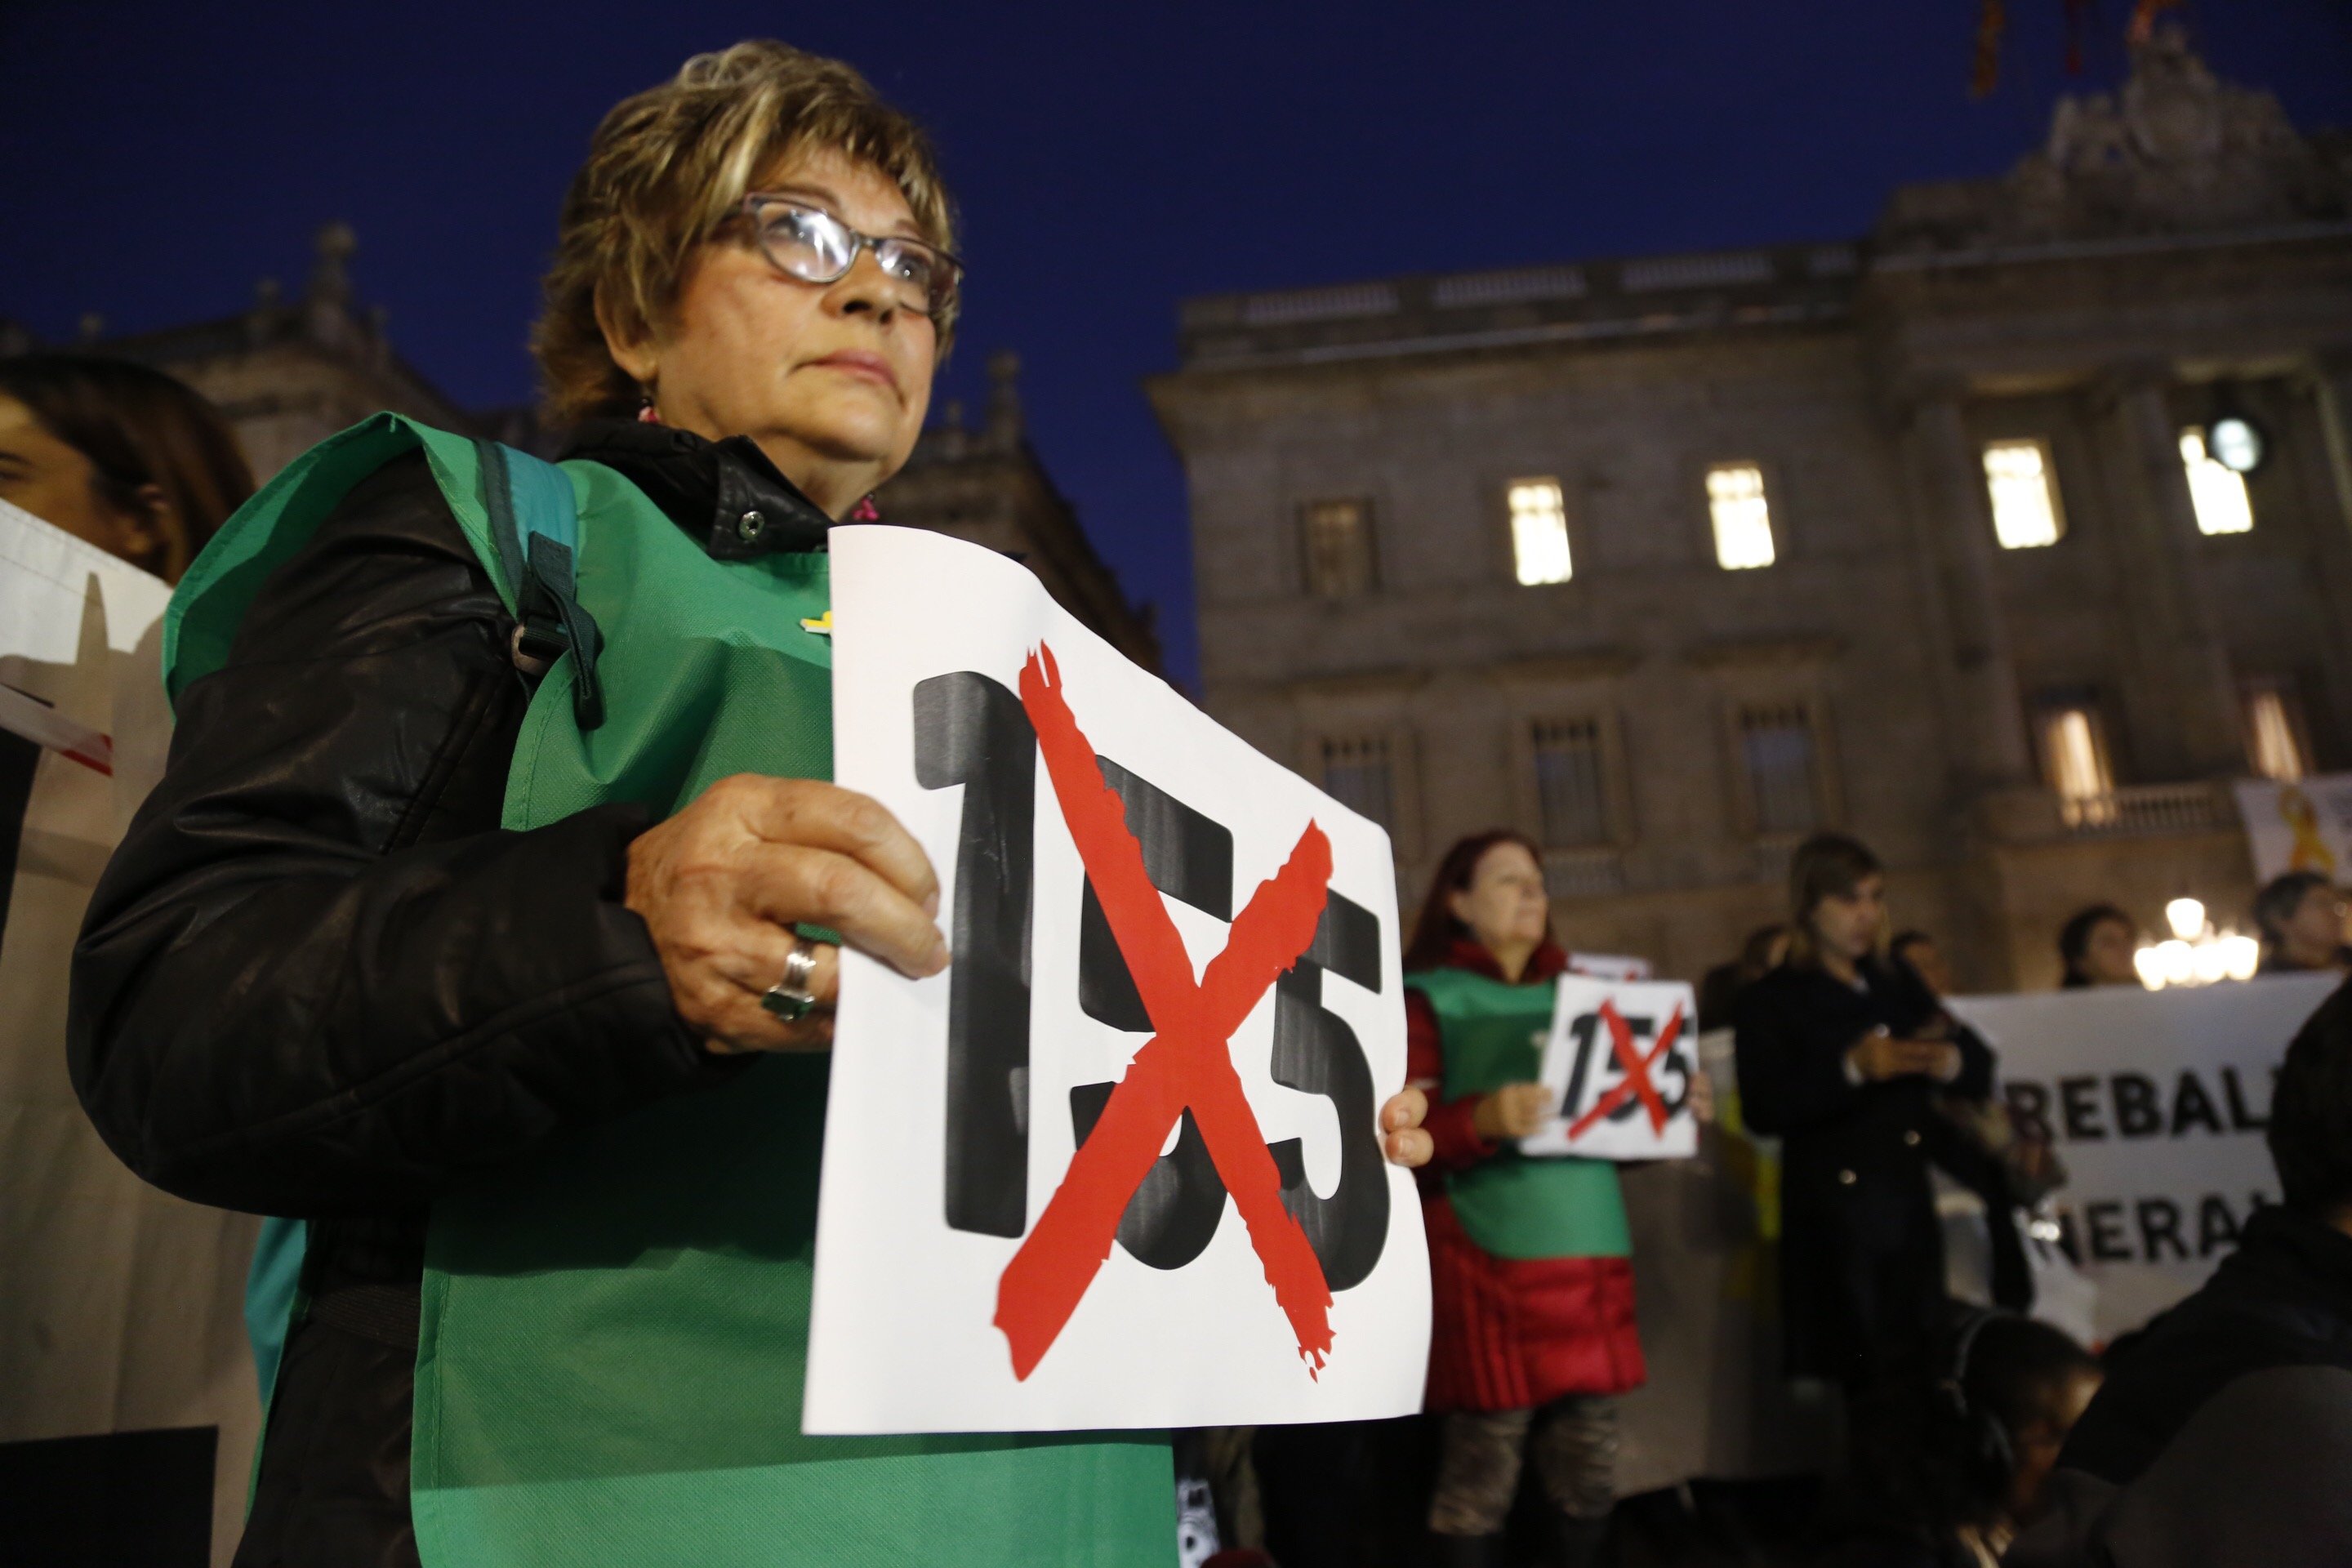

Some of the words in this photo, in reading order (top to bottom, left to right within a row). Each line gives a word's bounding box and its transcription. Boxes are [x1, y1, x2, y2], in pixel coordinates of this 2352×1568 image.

[913, 670, 1391, 1293] 155
[1561, 1013, 1695, 1122] 155
[2005, 1067, 2282, 1140] REBAL
